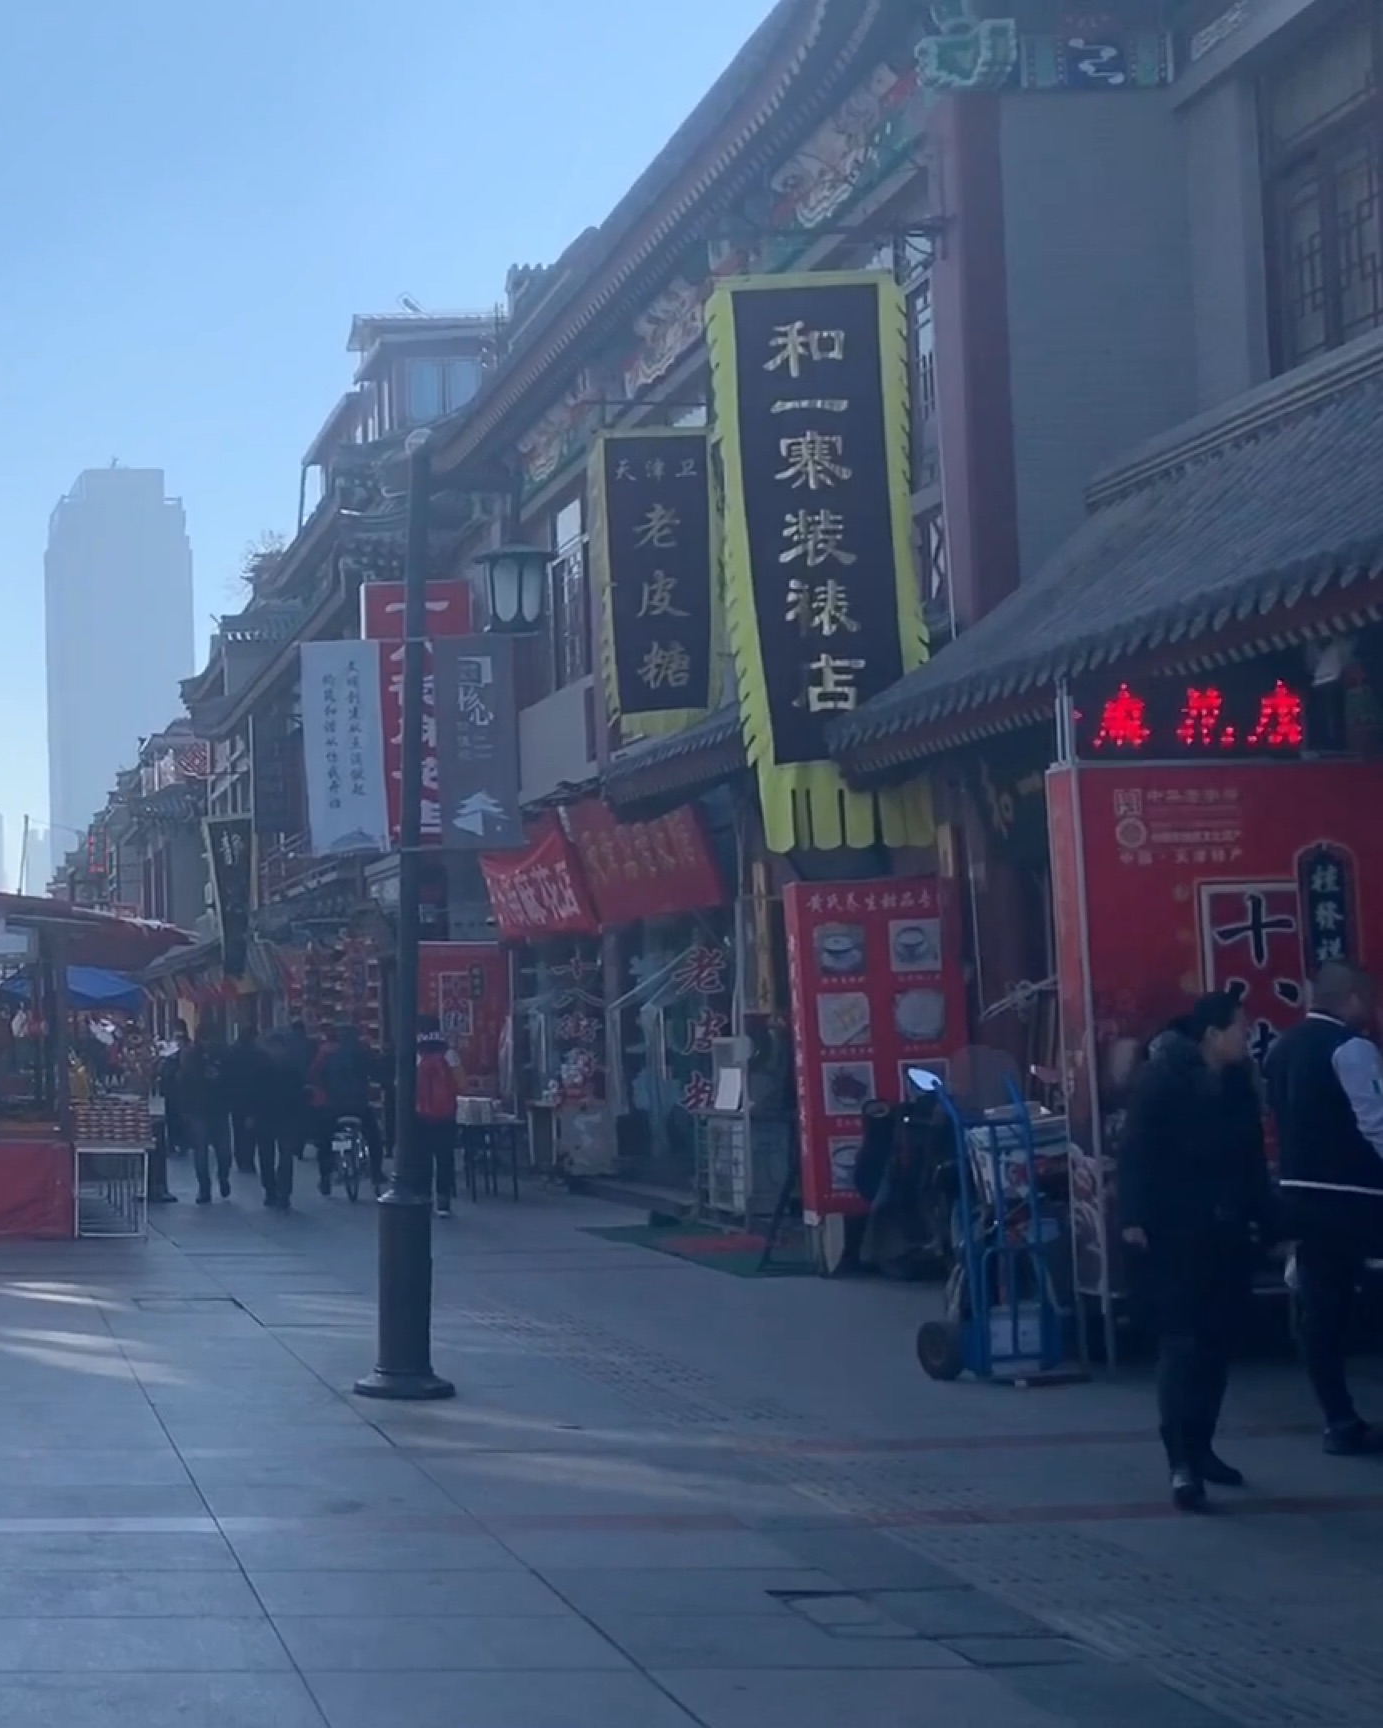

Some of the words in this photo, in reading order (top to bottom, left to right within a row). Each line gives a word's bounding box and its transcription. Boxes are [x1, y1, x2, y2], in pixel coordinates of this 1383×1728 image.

[615, 459, 698, 482] 天津卫
[632, 503, 691, 689] 老皮糖
